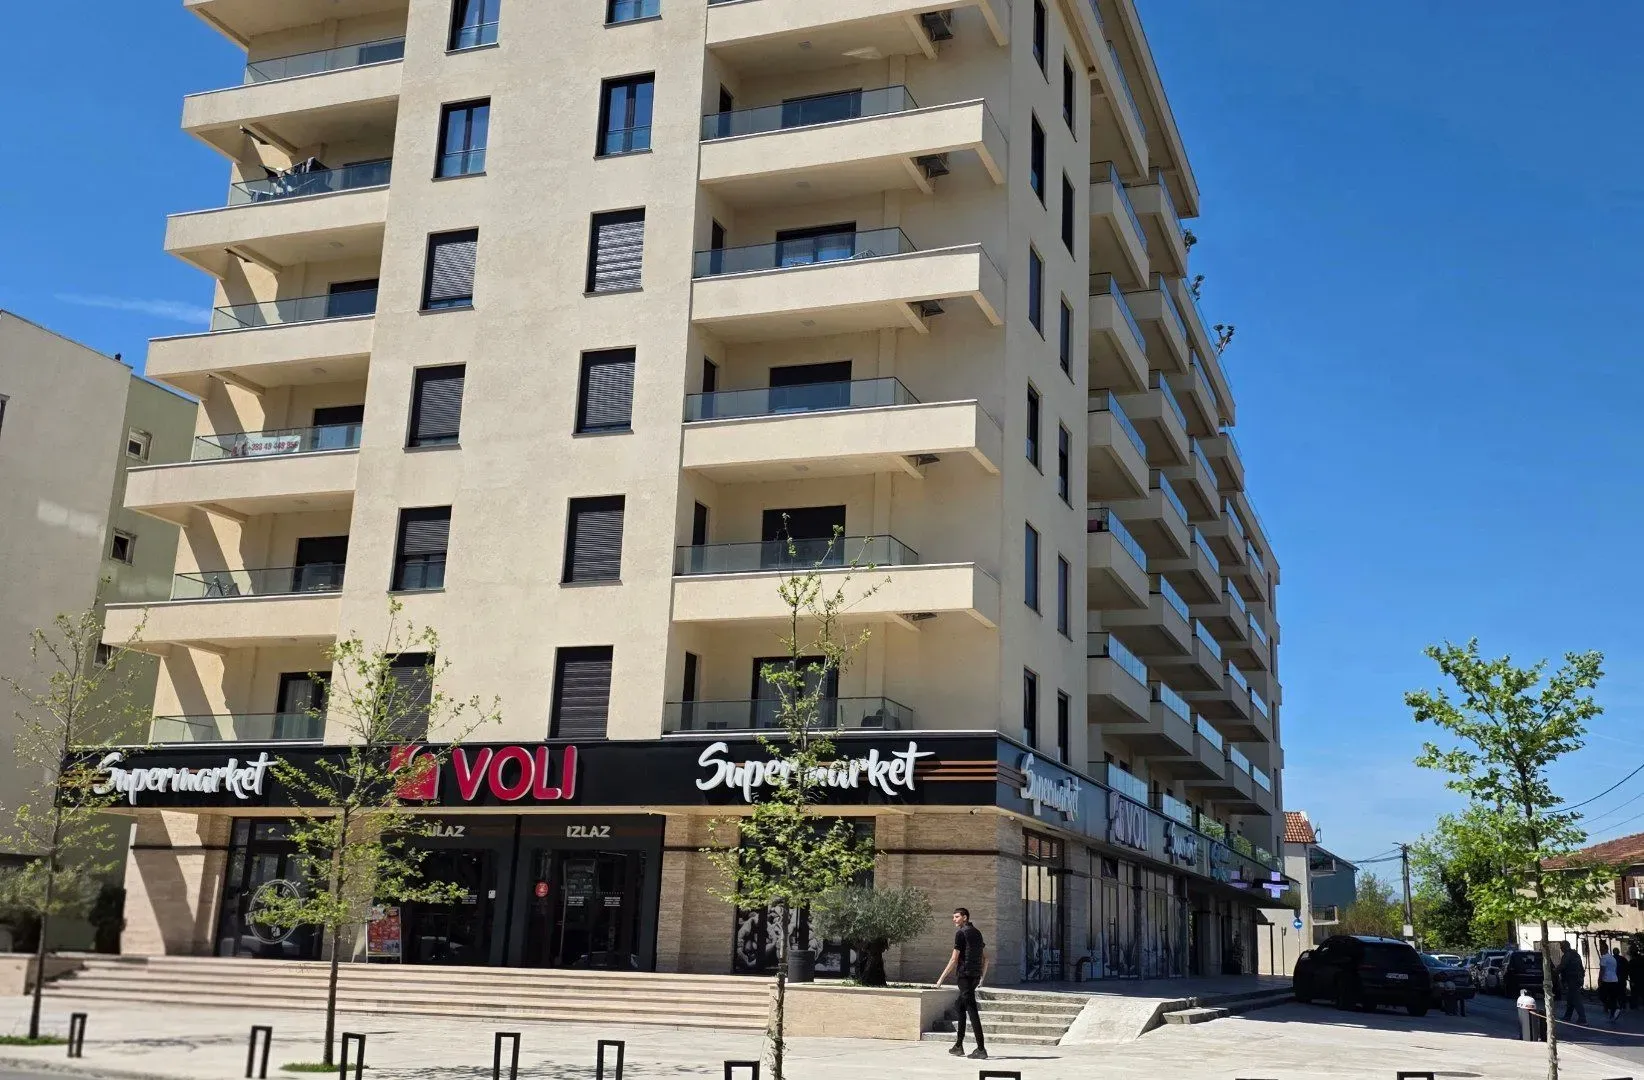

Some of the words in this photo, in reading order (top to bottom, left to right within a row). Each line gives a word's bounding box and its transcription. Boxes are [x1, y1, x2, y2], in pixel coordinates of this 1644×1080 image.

[92, 751, 278, 805] Supermarket
[452, 745, 578, 801] VOLI
[566, 825, 611, 838] IZLAZ
